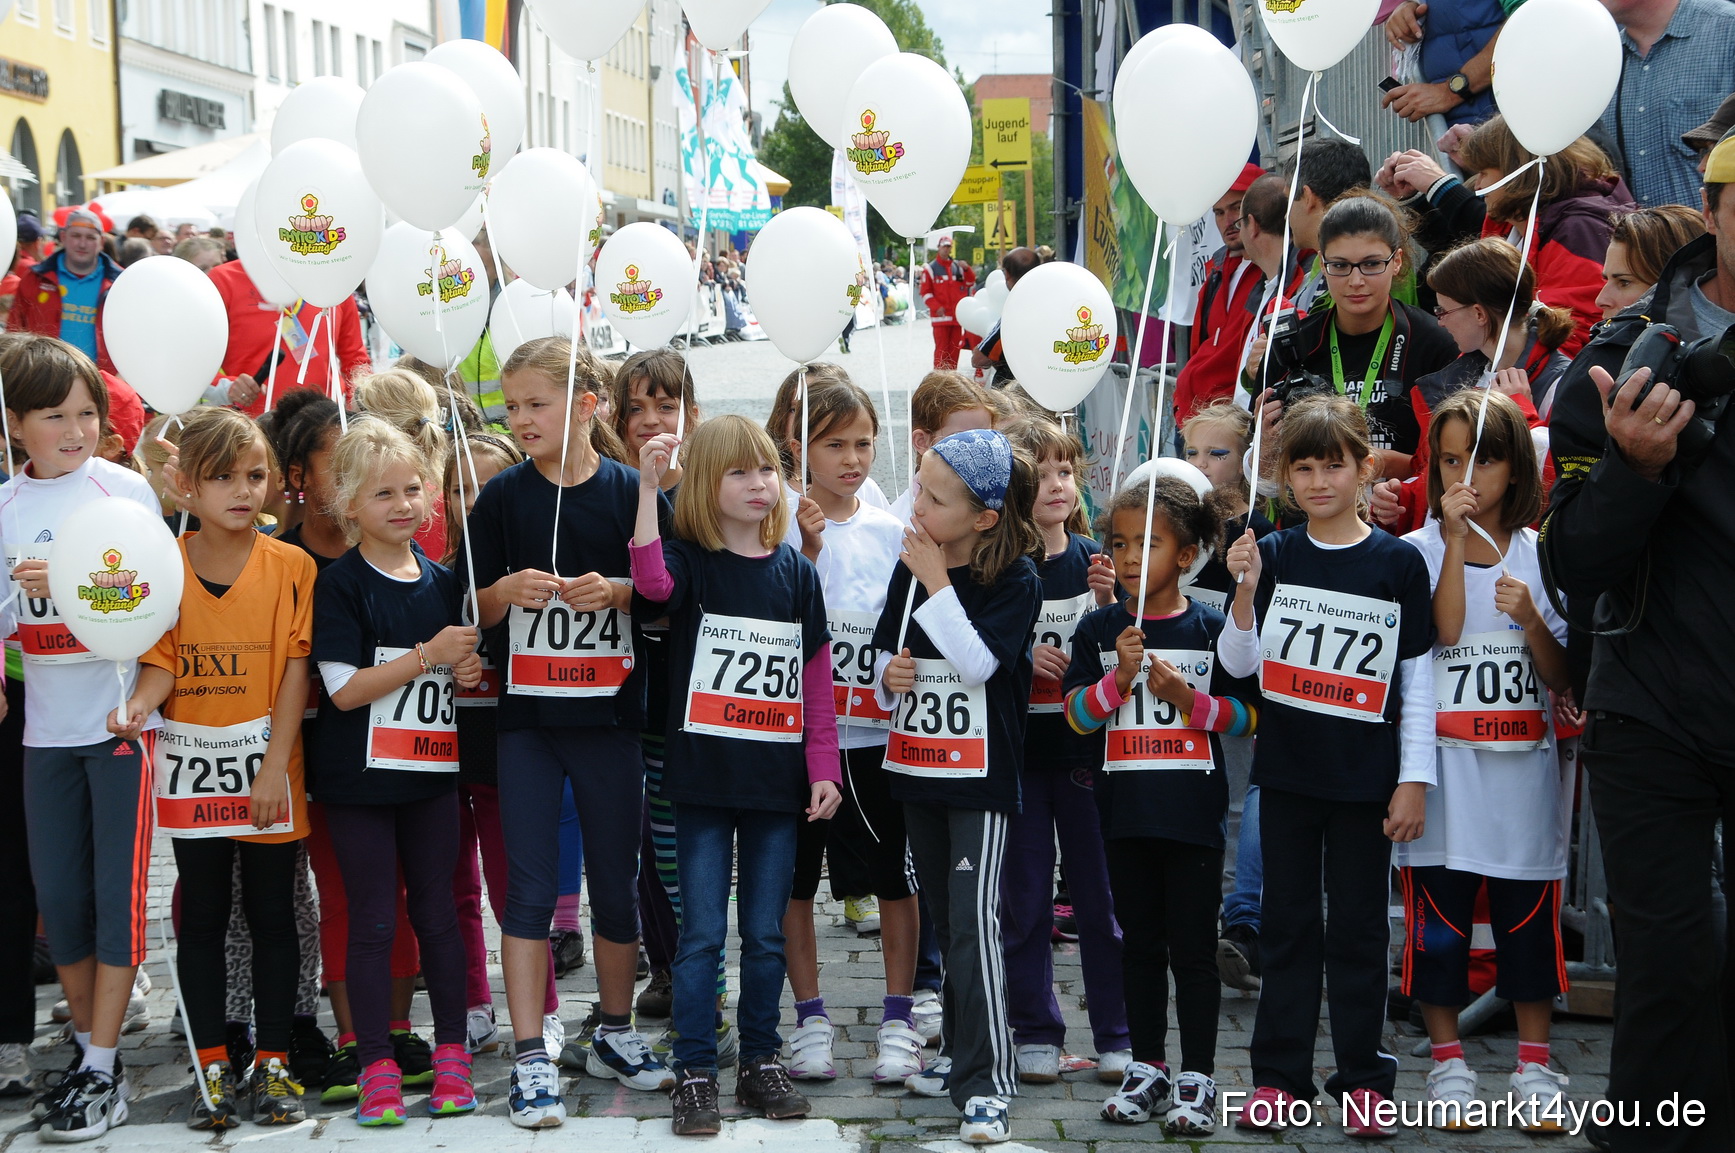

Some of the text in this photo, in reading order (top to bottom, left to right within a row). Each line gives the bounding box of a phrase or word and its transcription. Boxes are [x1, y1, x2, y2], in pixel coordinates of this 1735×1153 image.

[985, 118, 1029, 132] Jugend-
[997, 131, 1018, 143] lauf
[968, 186, 983, 195] lauf
[988, 202, 1012, 213] Blck
[279, 227, 346, 244] PHYTOKIDS
[992, 215, 1009, 239] A
[290, 242, 332, 256] stiftung
[976, 252, 982, 261] D
[1390, 334, 1405, 371] Canon
[78, 582, 150, 601] PHYTOKIDS
[90, 599, 134, 614] stiftung
[1273, 596, 1381, 624] PARTL Neumarkt
[523, 606, 621, 650] 7024
[702, 626, 797, 647] PARTL Neumar
[37, 631, 77, 649] Luca
[623, 645, 630, 653] W
[1280, 617, 1383, 677] 7172
[1266, 650, 1271, 658] 3
[1435, 647, 1479, 661] PARTL
[547, 663, 596, 682] Lucia
[712, 647, 799, 699] 7258
[1380, 672, 1388, 680] W
[207, 686, 247, 695] VISION
[696, 681, 702, 689] 3
[1291, 673, 1354, 703] Leonie
[1447, 660, 1539, 705] 7034
[393, 680, 457, 725] 703
[377, 716, 382, 724] 3
[724, 703, 785, 727] Carolin
[974, 728, 982, 736] W
[1474, 717, 1528, 740] Erjona
[158, 730, 258, 749] PARTL Neumarkt
[414, 737, 453, 757] Mona
[1123, 735, 1183, 755] Liliana
[901, 741, 947, 763] Emma
[193, 802, 248, 823] Alicia
[1416, 895, 1427, 952] predator
